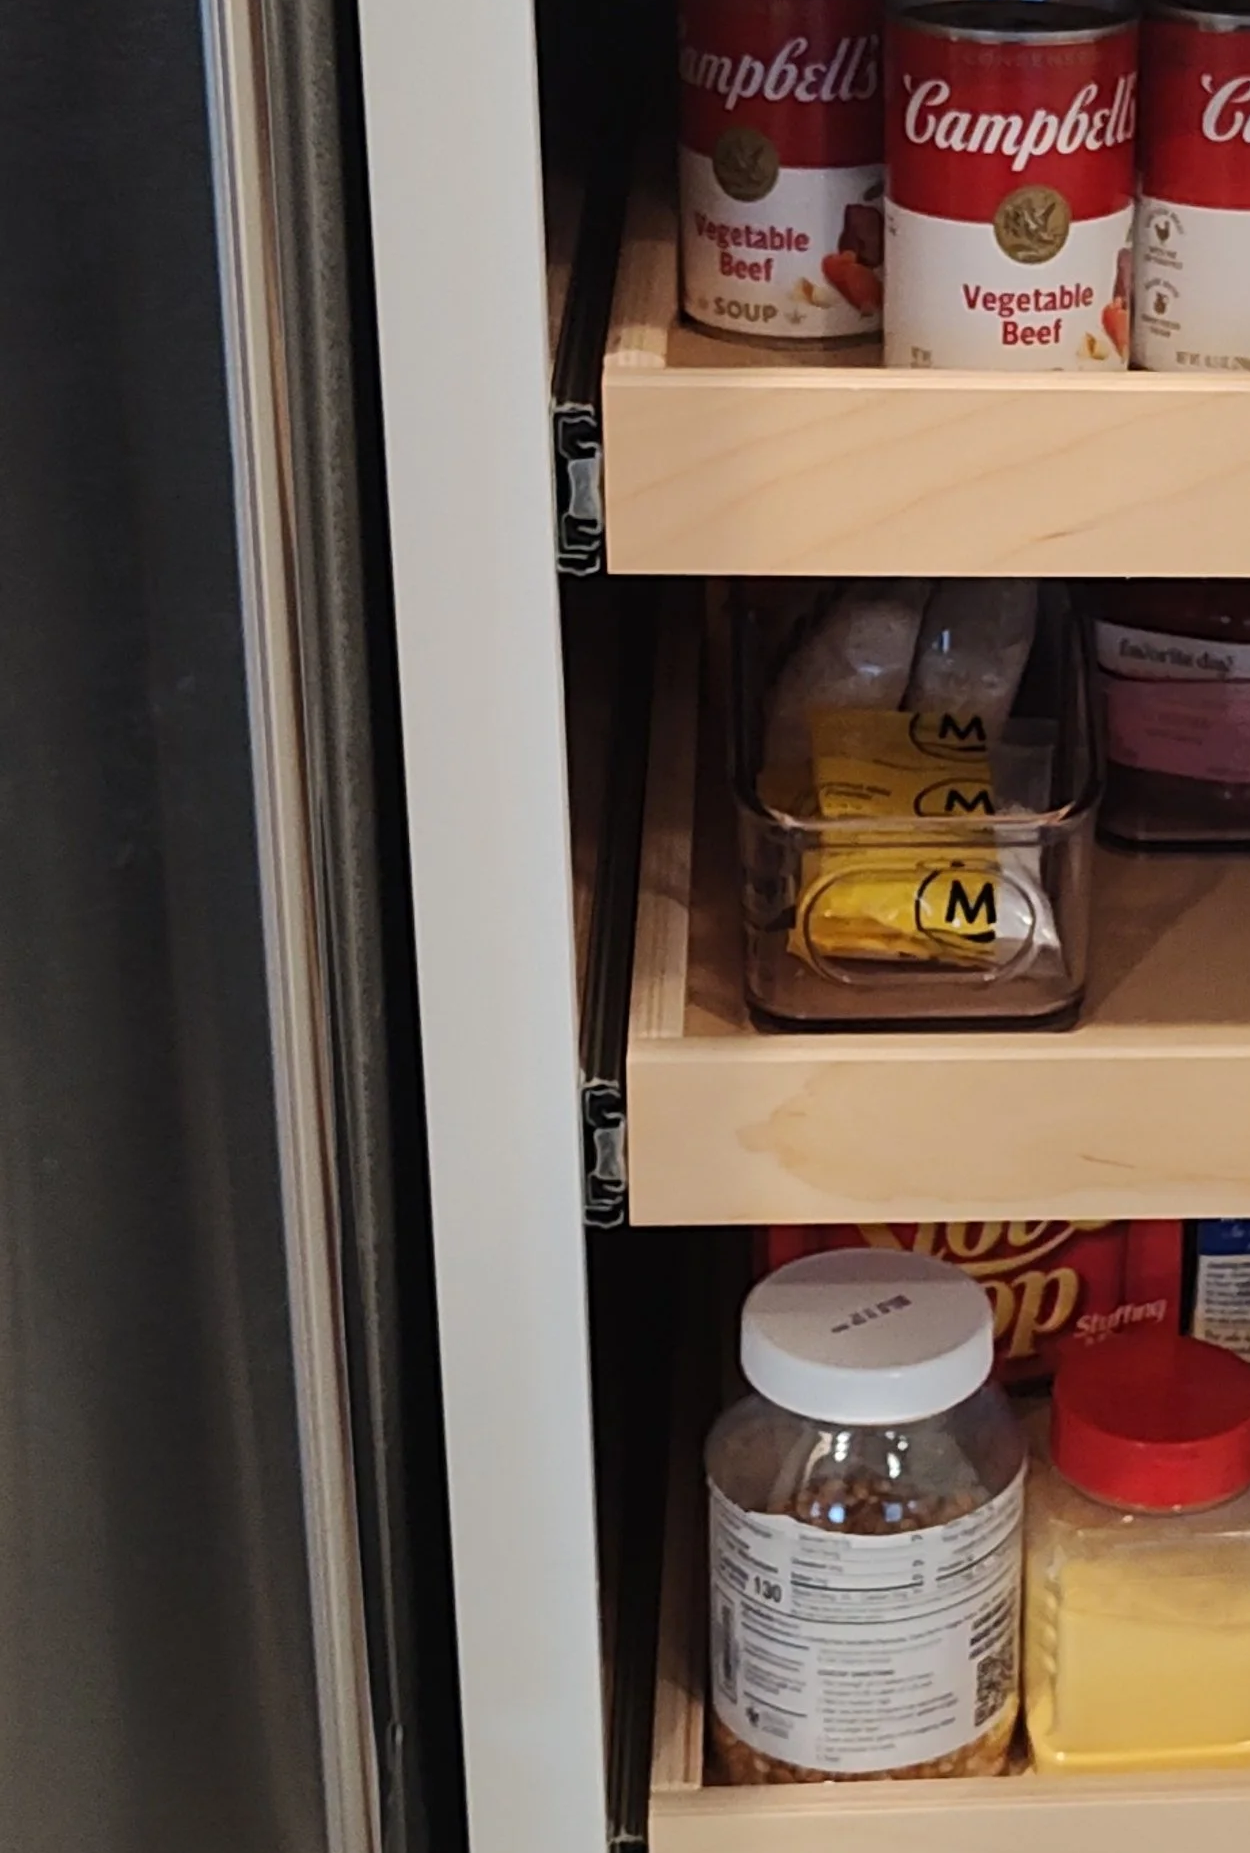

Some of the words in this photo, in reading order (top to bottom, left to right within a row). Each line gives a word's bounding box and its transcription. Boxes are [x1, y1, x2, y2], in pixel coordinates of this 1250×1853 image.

[680, 34, 880, 111] ampbell's
[695, 213, 810, 251] Vegetable
[720, 252, 775, 282] Beef
[714, 297, 777, 323] SOUP
[962, 283, 1094, 317] Vegetable
[1001, 319, 1062, 345] Beef
[938, 713, 987, 740] M
[945, 790, 995, 815] M
[945, 880, 996, 924] M
[1075, 1299, 1167, 1337] Stuffing
[753, 1576, 782, 1603] 130
